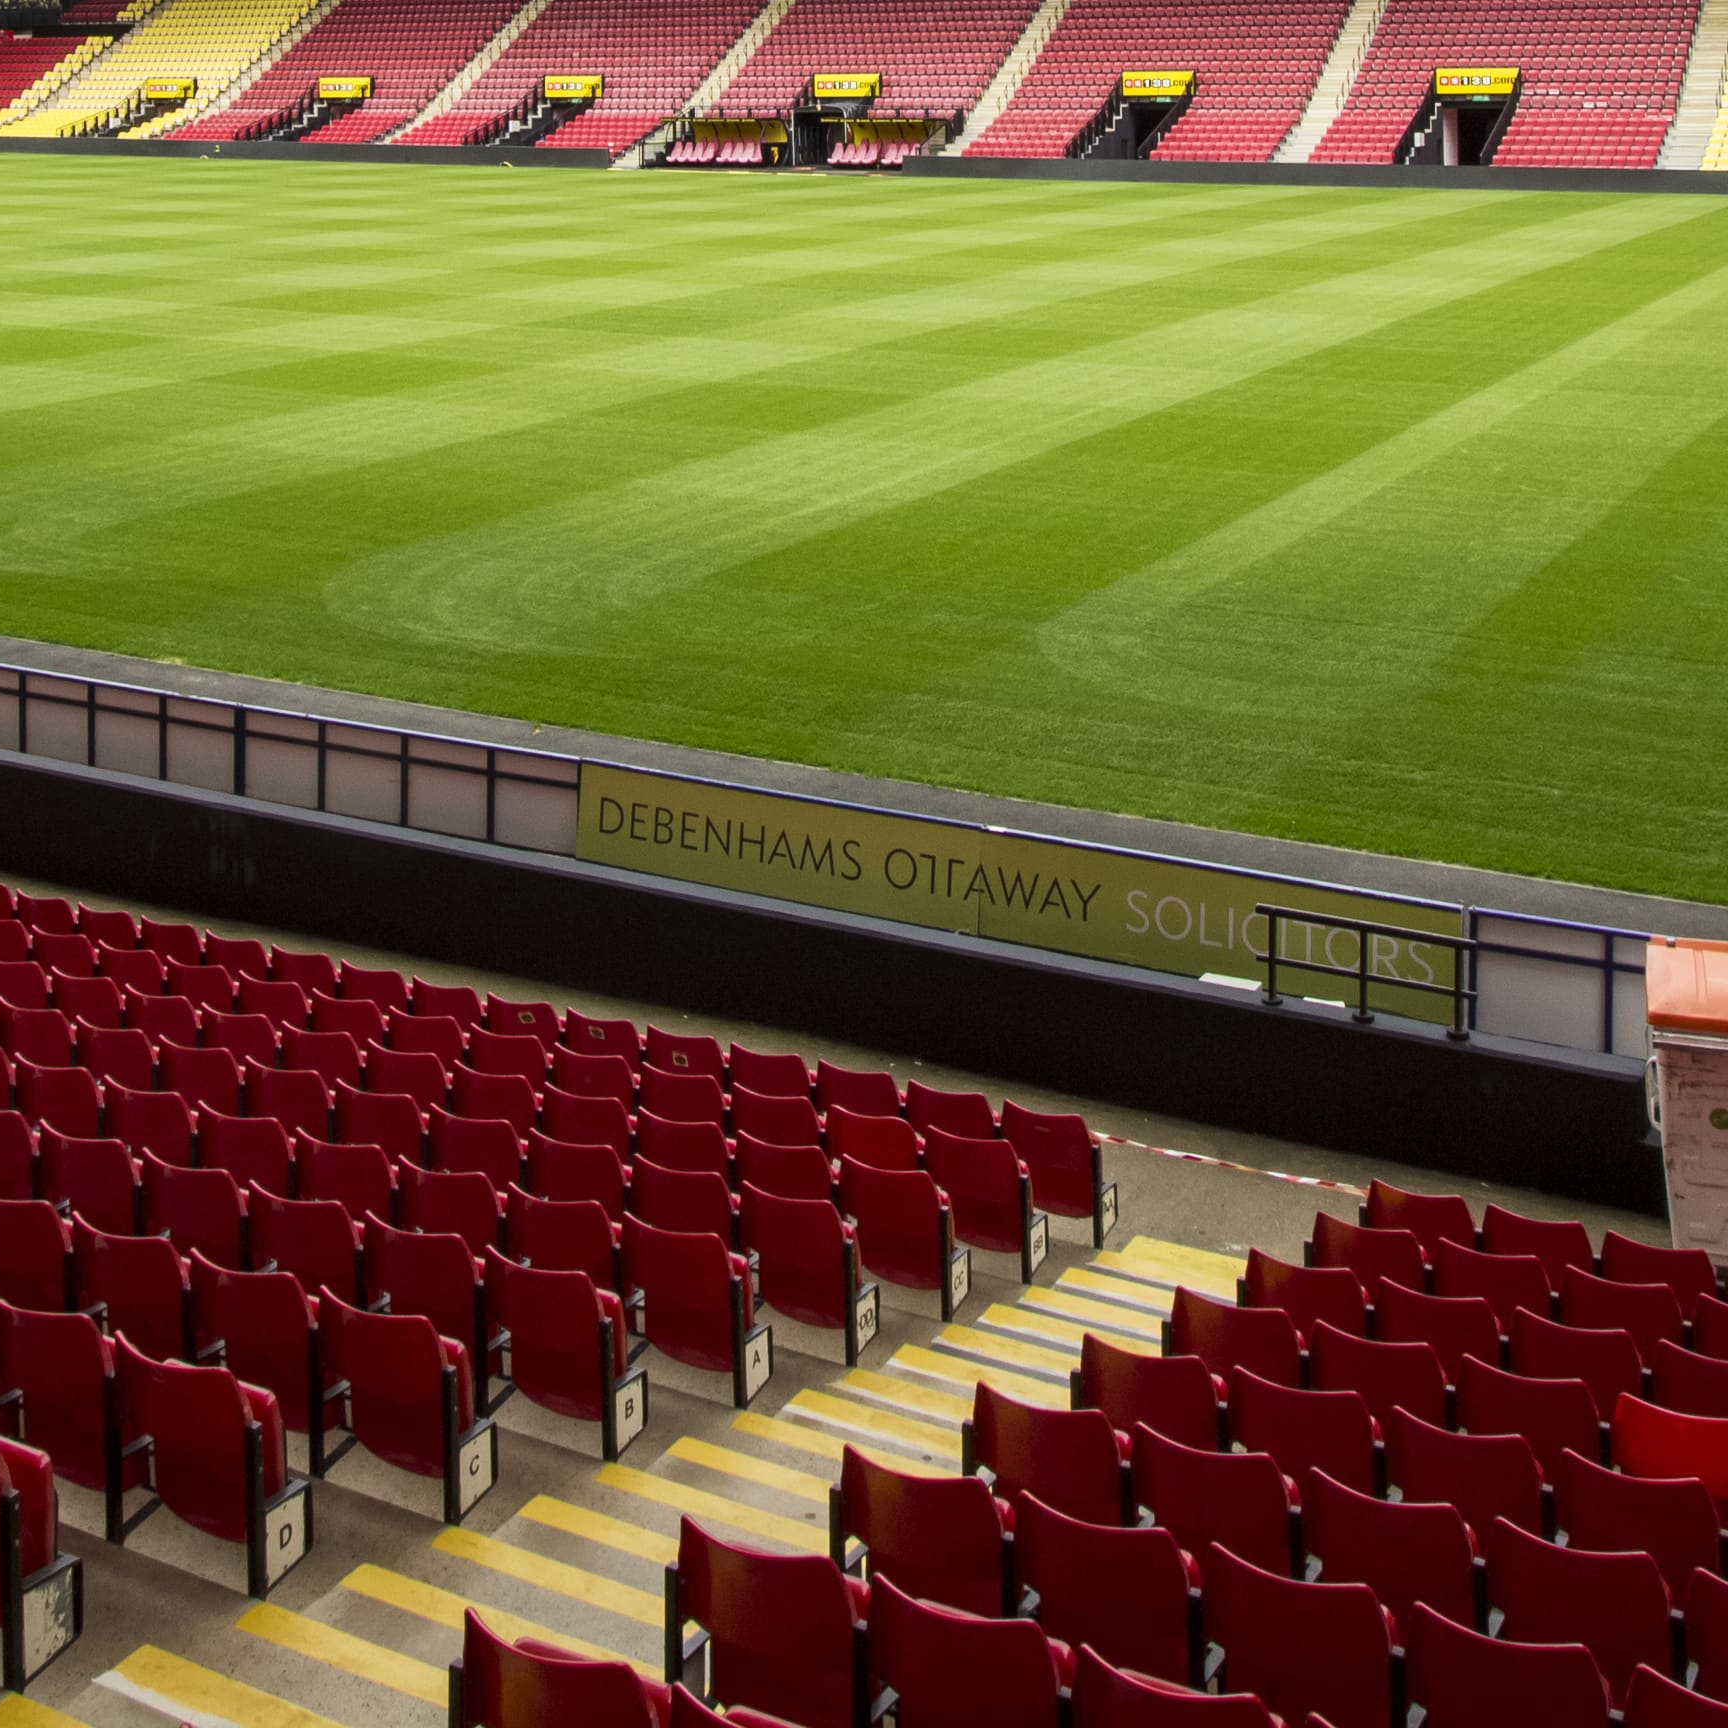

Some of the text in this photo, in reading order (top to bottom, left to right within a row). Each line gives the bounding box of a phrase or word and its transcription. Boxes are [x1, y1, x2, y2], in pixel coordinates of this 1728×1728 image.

[599, 797, 1434, 985] DEBENHAMS OTTAWAY SOLICITORS
[1033, 1234, 1044, 1253] BB
[859, 1308, 875, 1331] DD
[752, 1349, 761, 1369] A
[625, 1398, 634, 1420] B
[469, 1455, 480, 1475] C
[280, 1523, 293, 1550] D
